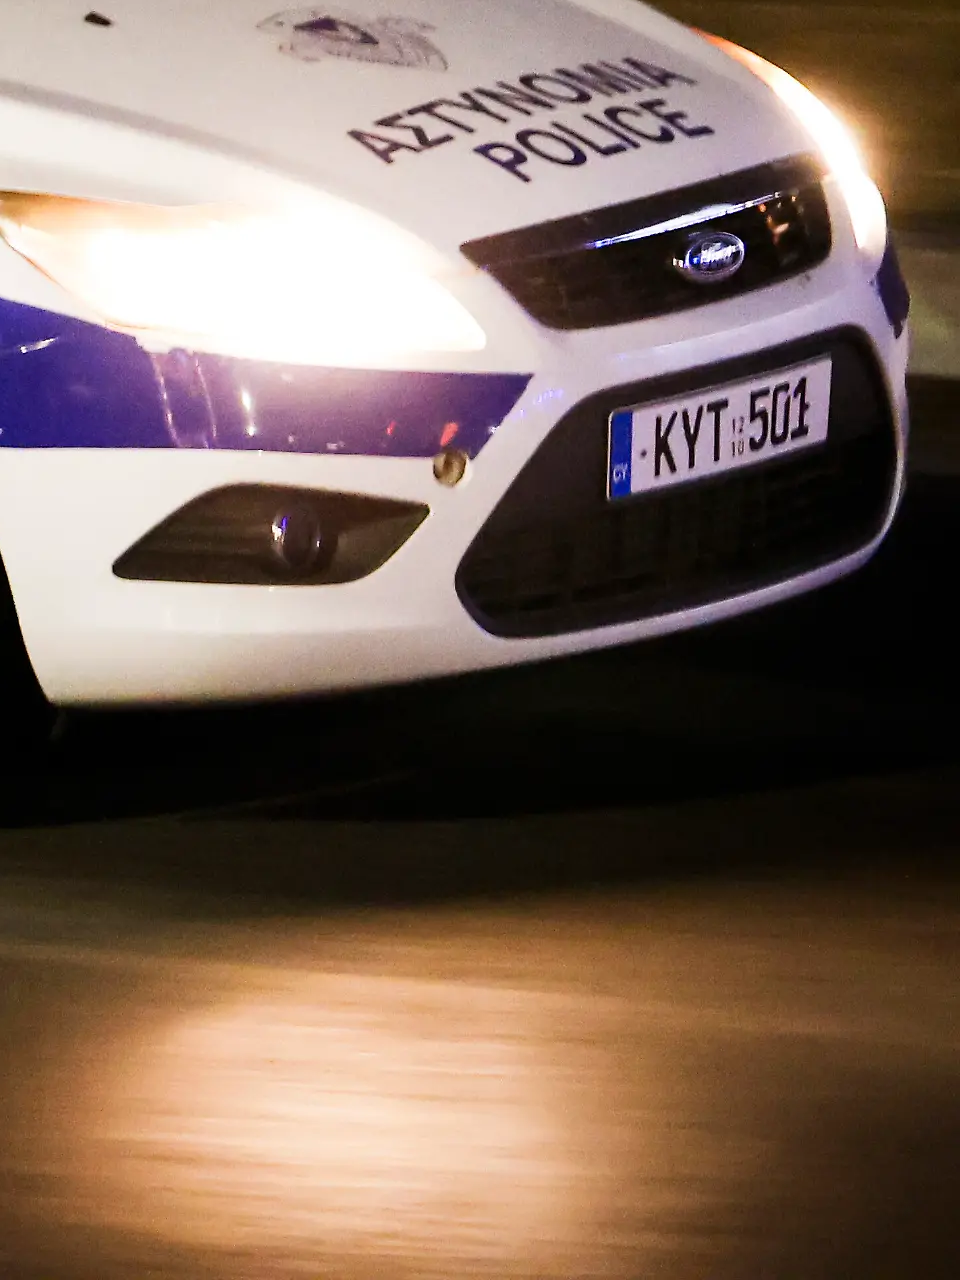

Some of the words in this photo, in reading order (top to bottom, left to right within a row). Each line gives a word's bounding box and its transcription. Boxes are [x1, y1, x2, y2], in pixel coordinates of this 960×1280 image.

[346, 57, 697, 165] ΑΣΤΥΝΟΜΙΑ
[473, 97, 715, 183] POLICE
[612, 461, 628, 483] CY
[653, 398, 729, 477] KYT
[748, 376, 810, 452] 501
